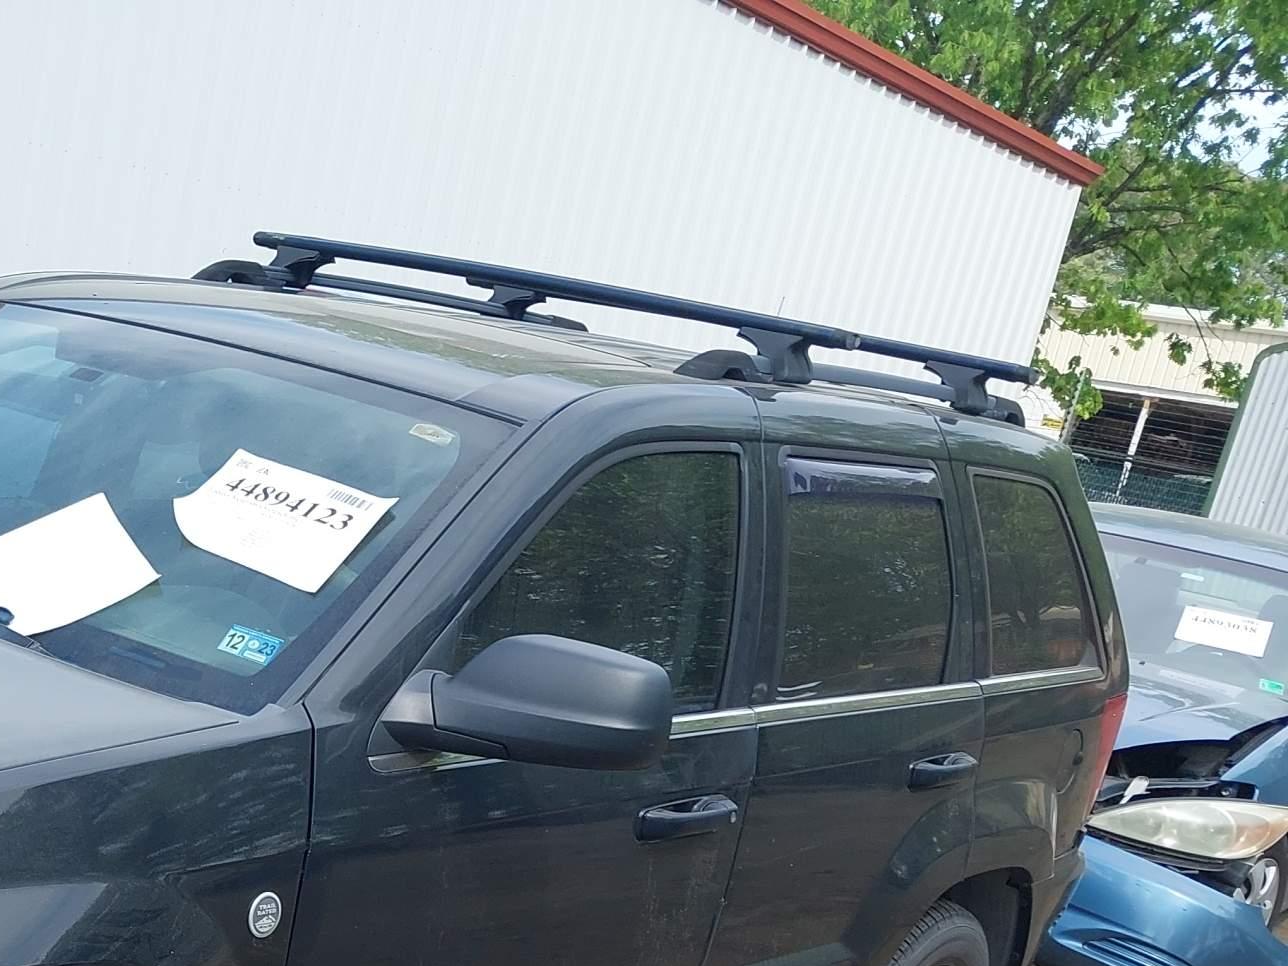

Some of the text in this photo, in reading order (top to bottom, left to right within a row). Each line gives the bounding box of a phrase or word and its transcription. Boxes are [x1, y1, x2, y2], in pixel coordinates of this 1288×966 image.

[225, 478, 354, 530] 44894123
[225, 632, 246, 650] 12
[258, 642, 276, 656] 23
